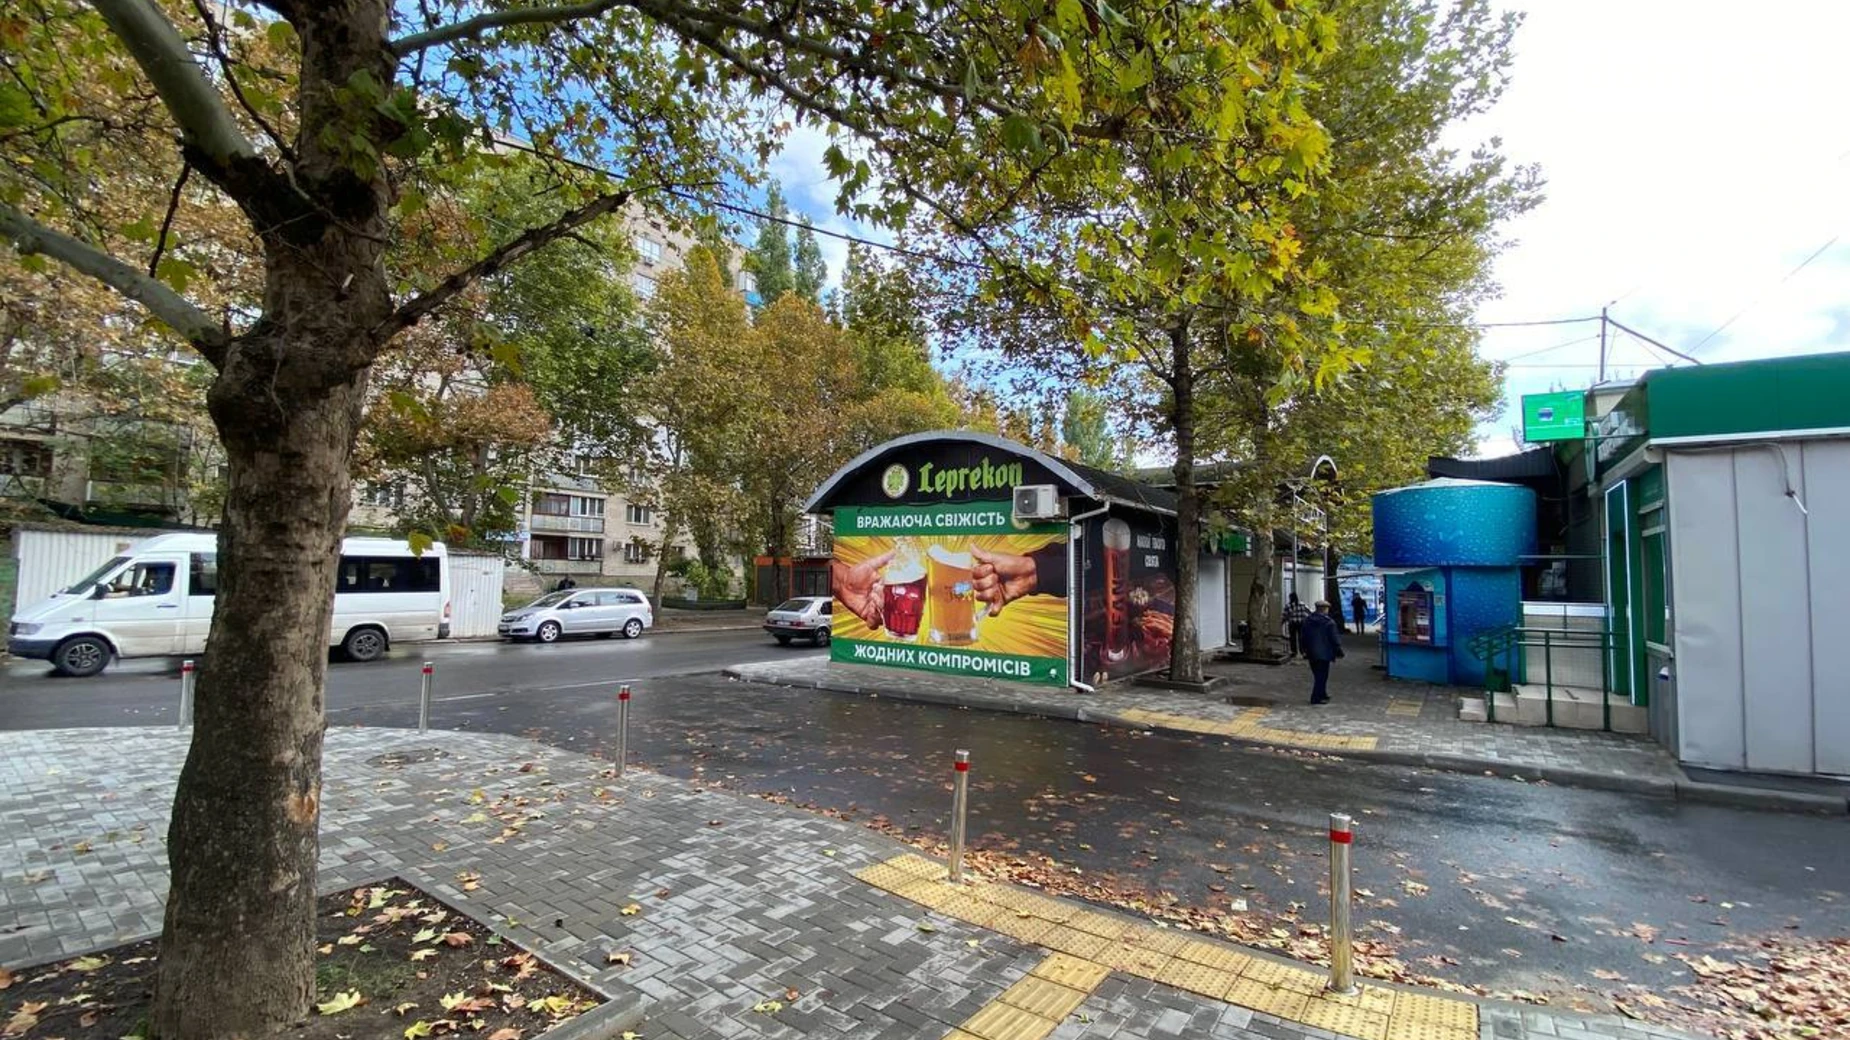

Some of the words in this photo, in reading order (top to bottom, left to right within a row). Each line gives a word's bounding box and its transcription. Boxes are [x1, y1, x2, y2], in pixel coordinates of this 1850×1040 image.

[918, 457, 1023, 498] Leprekon
[856, 514, 932, 529] ВРАЖАЮЧА
[935, 512, 1006, 527] СВІЖІСТЬ
[854, 644, 915, 664] ЖОДНИХ
[918, 651, 1031, 676] КОМПРОМІСІВ
